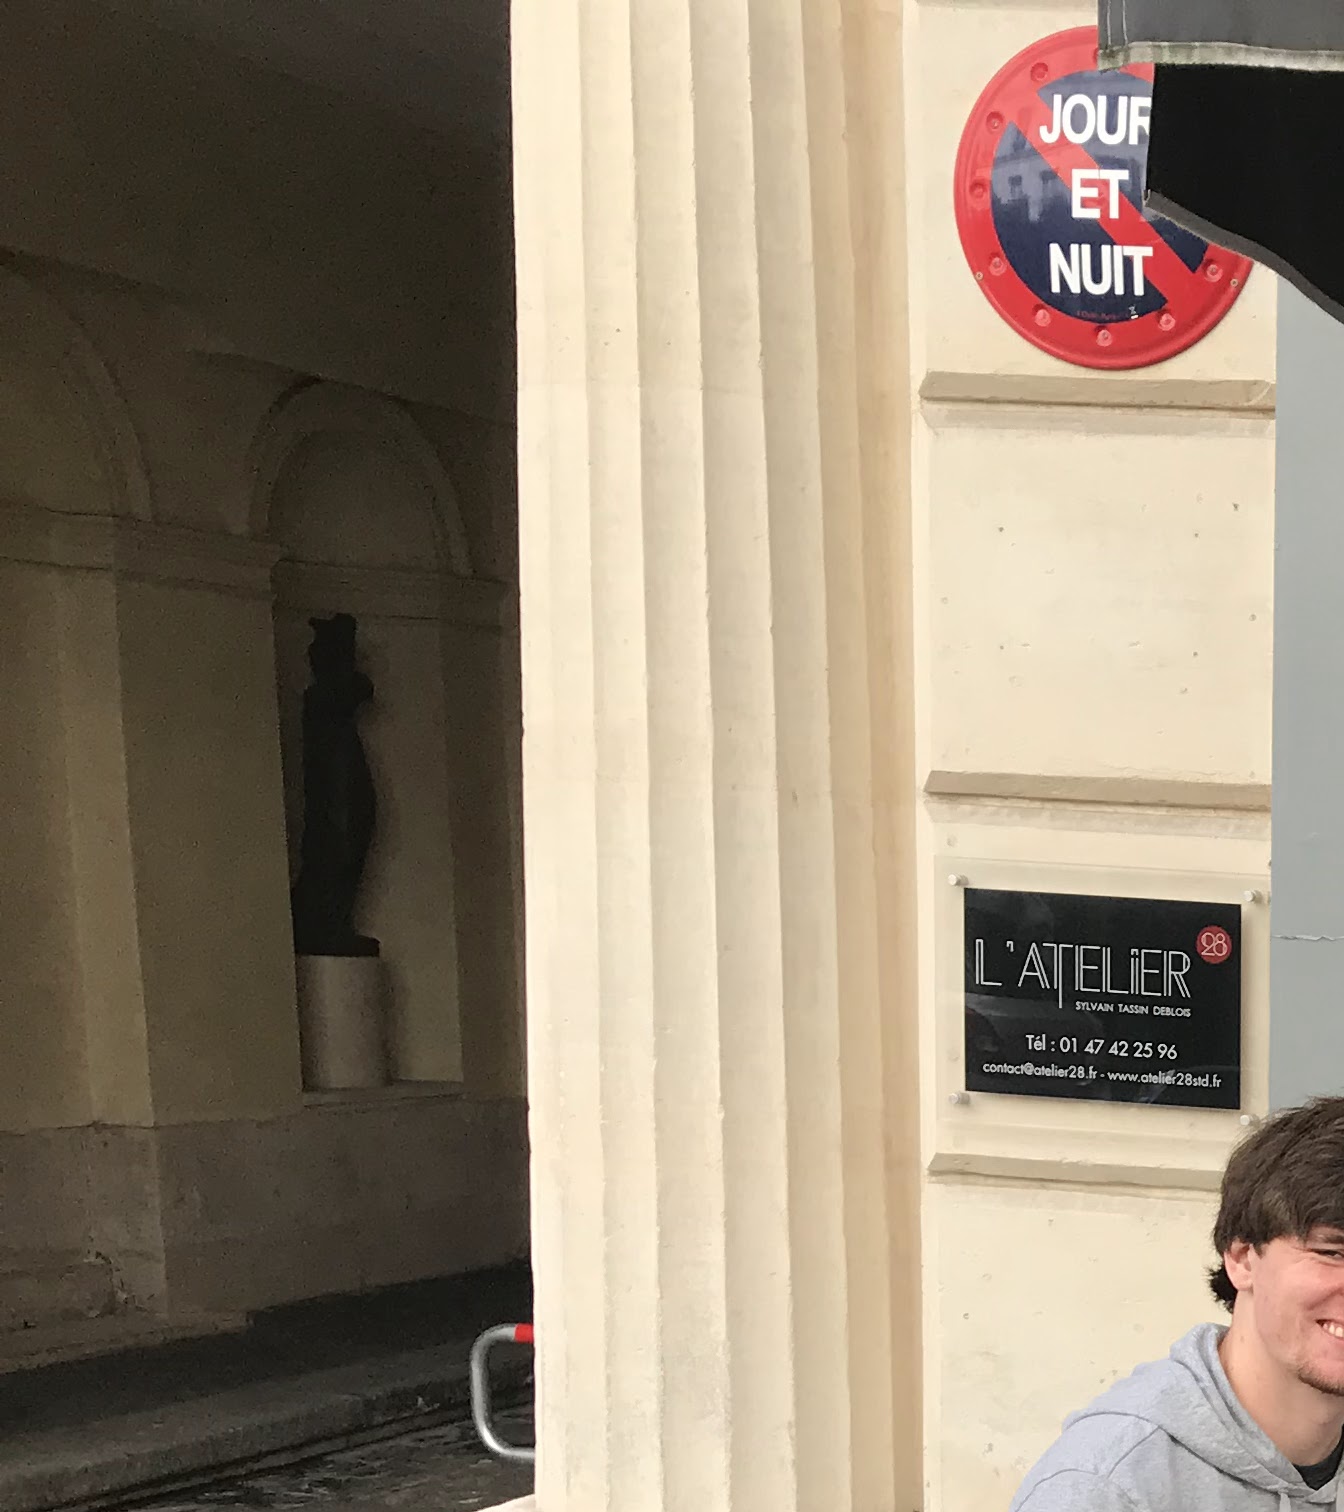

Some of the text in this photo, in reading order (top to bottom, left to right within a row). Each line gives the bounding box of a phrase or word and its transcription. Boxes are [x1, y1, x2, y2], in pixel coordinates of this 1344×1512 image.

[1040, 94, 1152, 145] JOUR
[1071, 168, 1129, 219] ET
[1050, 243, 1153, 296] NUIT
[1200, 931, 1228, 957] 28
[1075, 1001, 1191, 1017] SYLVAIN TASSIN DEBLOIS
[1026, 1034, 1046, 1051] Tél
[1059, 1037, 1078, 1053] 01
[1084, 1039, 1104, 1055] 47
[1109, 1041, 1129, 1057] 42
[1133, 1042, 1153, 1059] 25
[1157, 1044, 1178, 1060] 96
[983, 1062, 1098, 1080] contact@atelier28.fr
[1107, 1069, 1222, 1088] www.atelier28std.fr
